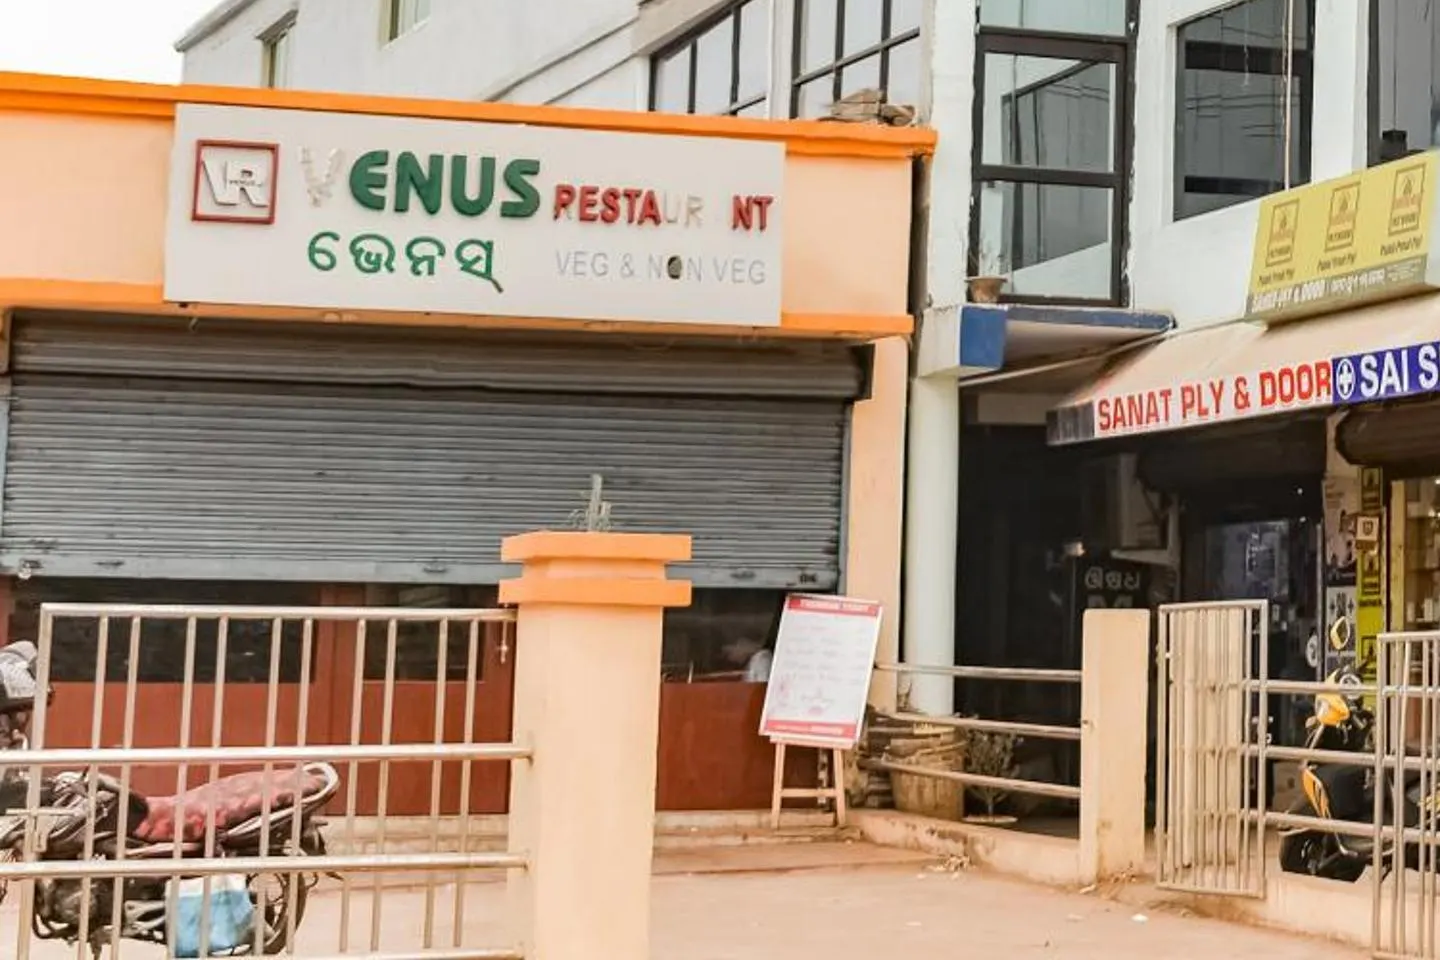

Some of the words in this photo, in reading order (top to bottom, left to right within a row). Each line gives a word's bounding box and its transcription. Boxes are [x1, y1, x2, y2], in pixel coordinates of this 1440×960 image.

[553, 183, 773, 233] RESTAURNT
[555, 250, 609, 279] VEG
[620, 252, 635, 278] &
[649, 253, 702, 282] NON
[712, 257, 767, 286] VEG
[1098, 388, 1172, 431] SANAT
[1180, 379, 1224, 420] PLY
[1233, 376, 1250, 409] &
[1259, 360, 1331, 407] DOOR
[1359, 348, 1409, 398] SAI
